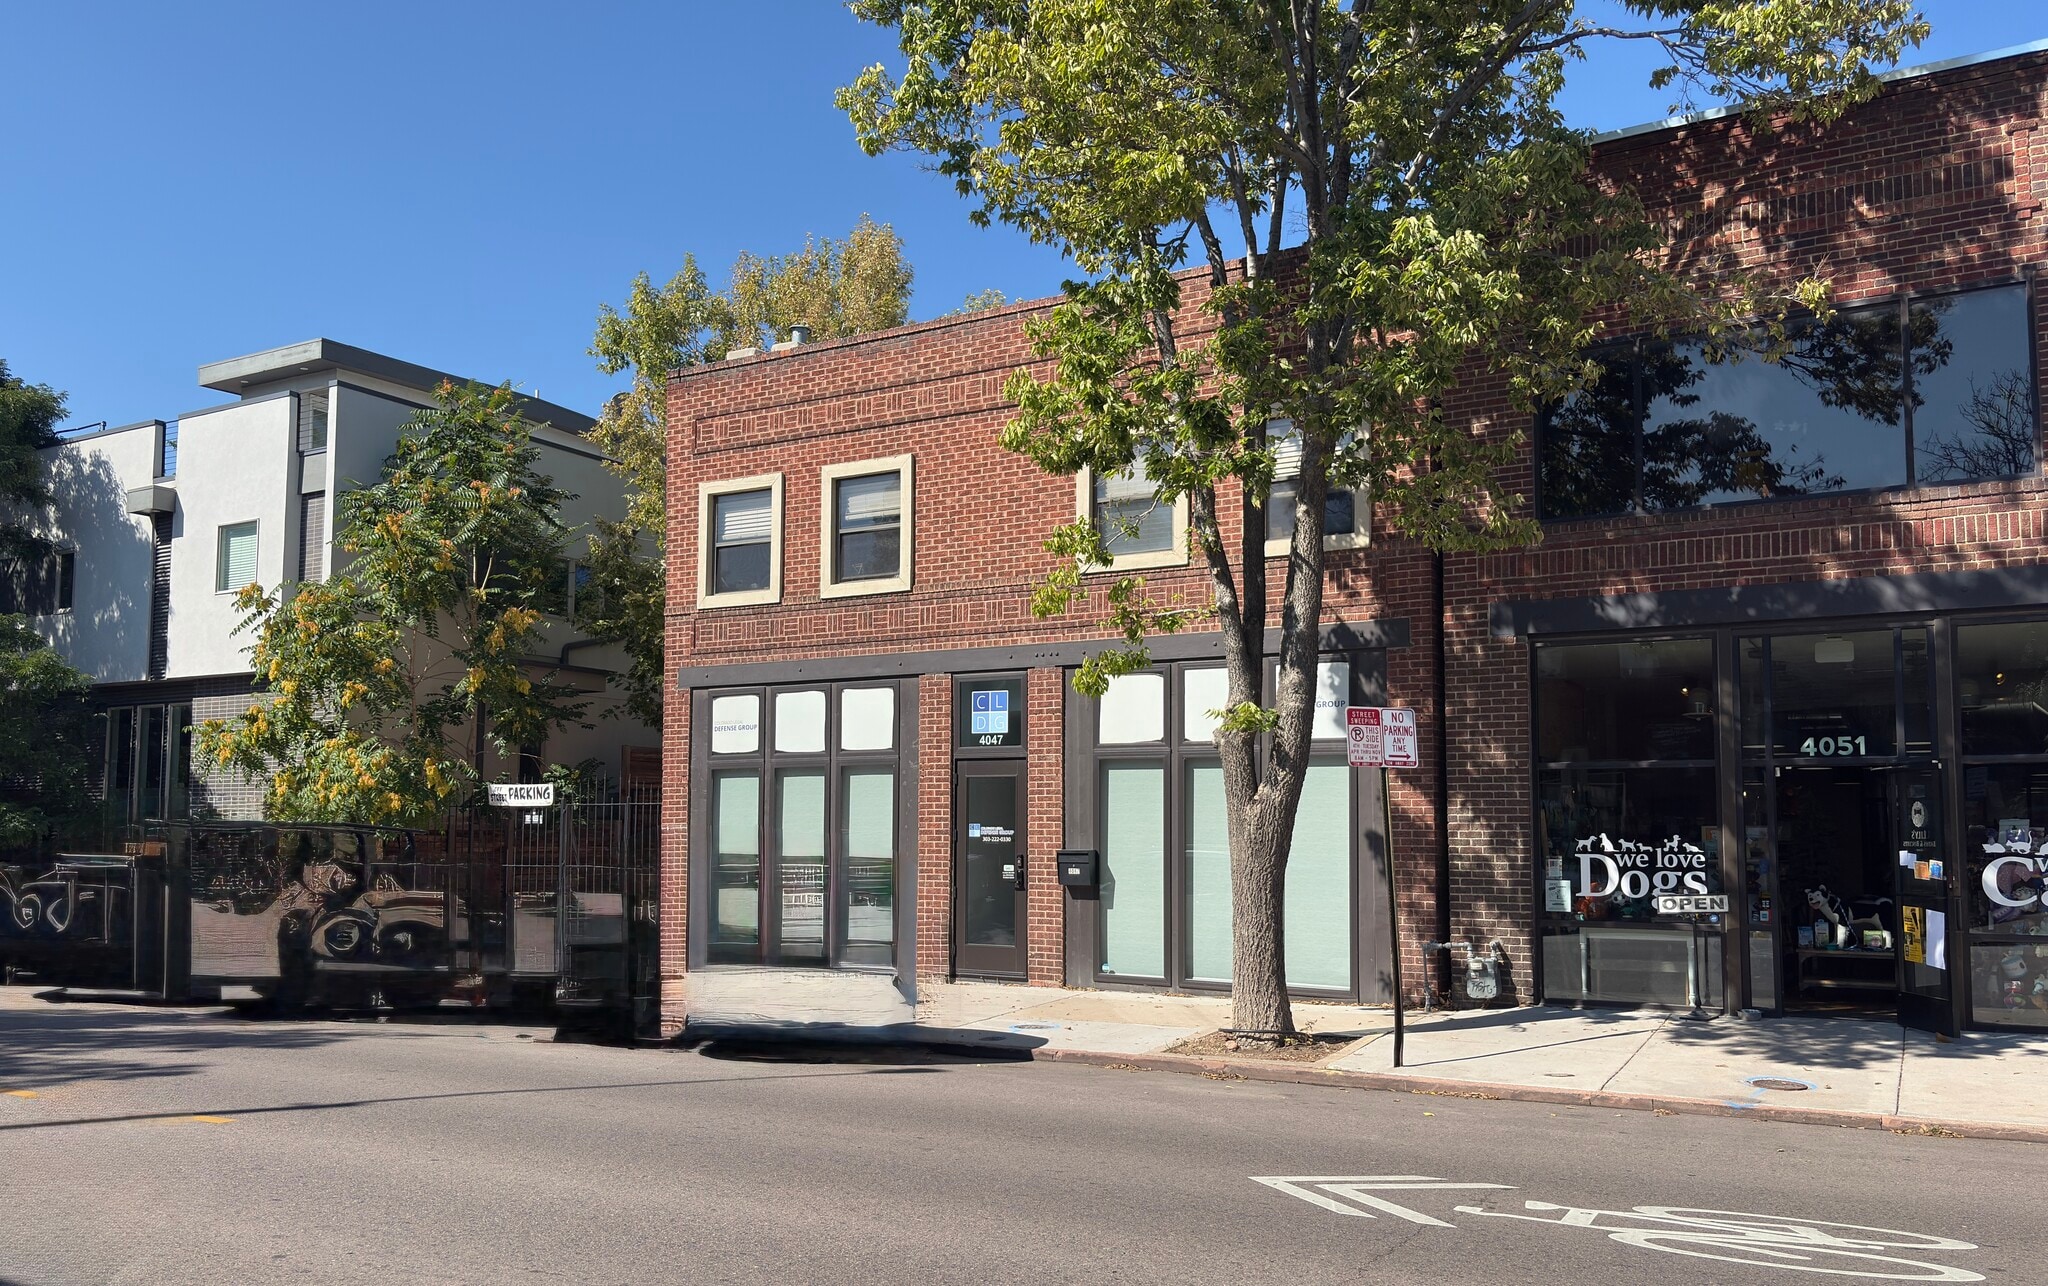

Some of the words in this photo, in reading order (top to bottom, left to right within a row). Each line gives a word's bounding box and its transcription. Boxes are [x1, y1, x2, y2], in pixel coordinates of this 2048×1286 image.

[1316, 700, 1346, 708] GROUP
[1391, 712, 1404, 723] NO
[1365, 727, 1379, 735] THIS
[1383, 725, 1413, 737] PARKING
[979, 735, 1004, 746] 4047
[1365, 735, 1380, 743] SIDE
[1392, 737, 1406, 745] ANY
[1392, 744, 1407, 753] TIME
[1800, 735, 1866, 757] 4051
[508, 786, 551, 800] PARKING
[1614, 853, 1649, 868] we
[1655, 848, 1706, 868] love
[1575, 853, 1708, 910] Dogs
[1661, 896, 1726, 911] OPEN
